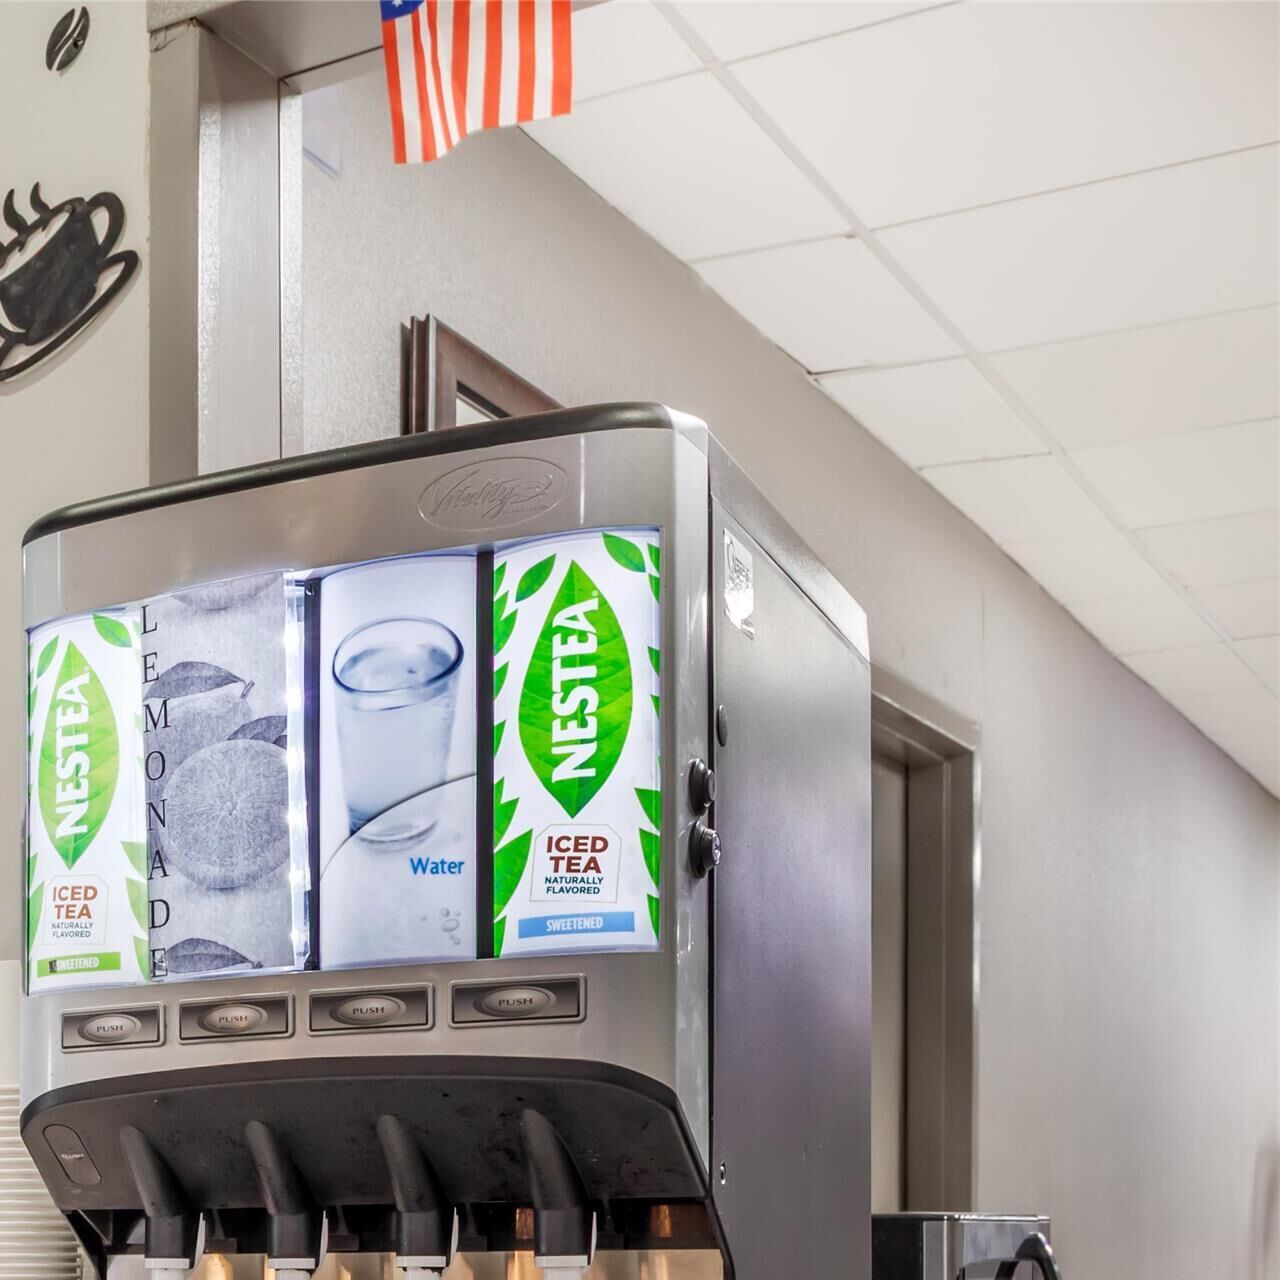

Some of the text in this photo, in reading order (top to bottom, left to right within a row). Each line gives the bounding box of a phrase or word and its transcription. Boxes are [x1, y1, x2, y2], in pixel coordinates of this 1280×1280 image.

[551, 597, 599, 783] NESTEA
[55, 672, 90, 839] NESTEA
[140, 604, 171, 978] LEMONADE
[546, 835, 609, 853] ICED
[410, 857, 465, 875] Water
[549, 856, 602, 873] TEA
[544, 876, 604, 885] NATURALLY
[52, 885, 98, 902] ICED
[546, 886, 601, 894] FLAVORED
[54, 904, 92, 919] TEA
[51, 921, 94, 930] NATURALLY
[546, 916, 604, 932] SWEETENED
[52, 930, 91, 938] FLAVORED
[498, 997, 533, 1007] PUSH
[352, 1006, 385, 1015] PUSH
[218, 1015, 248, 1023] PUSH
[96, 1024, 124, 1033] PUSH
